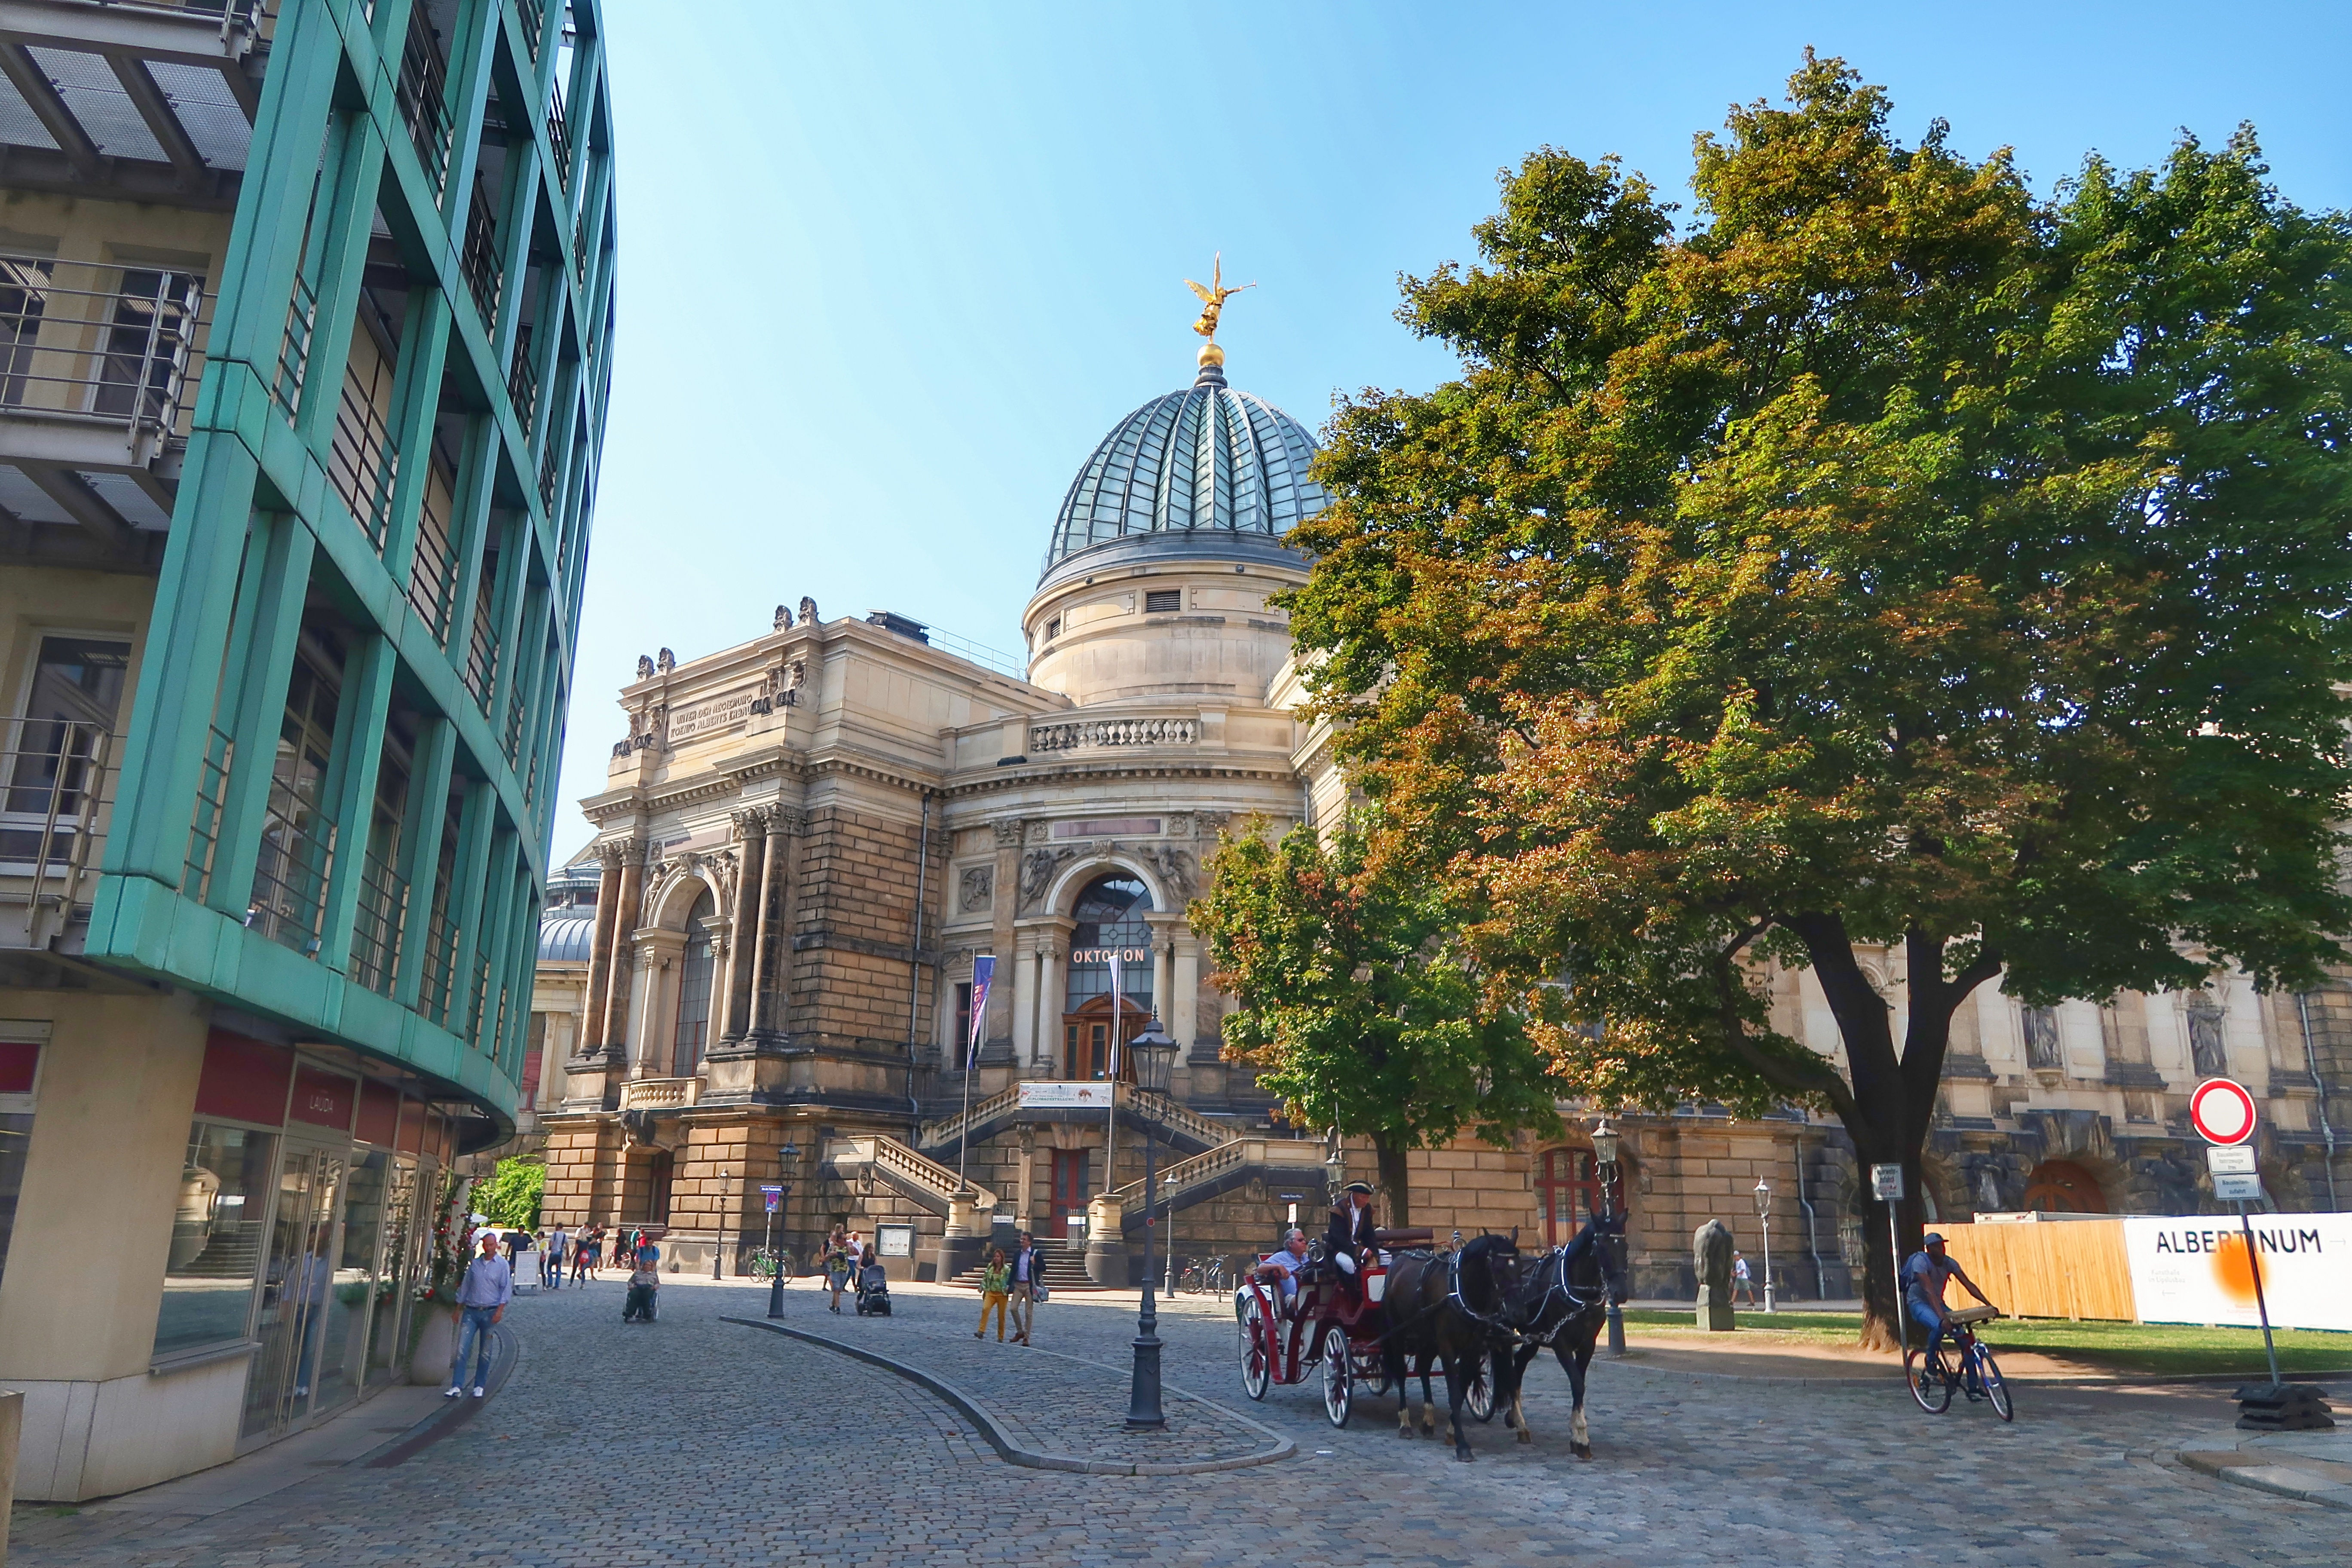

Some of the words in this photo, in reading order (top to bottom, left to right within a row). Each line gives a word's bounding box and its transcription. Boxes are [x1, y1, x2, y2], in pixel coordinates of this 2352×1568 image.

[671, 723, 695, 738] KOENIG
[697, 713, 727, 730] ALBERTS
[729, 706, 751, 721] ERBAU
[676, 710, 696, 725] UNTER
[698, 707, 710, 718] DER
[713, 694, 753, 713] REGIERUNG
[2156, 1229, 2322, 1253] ALBERTINUM
